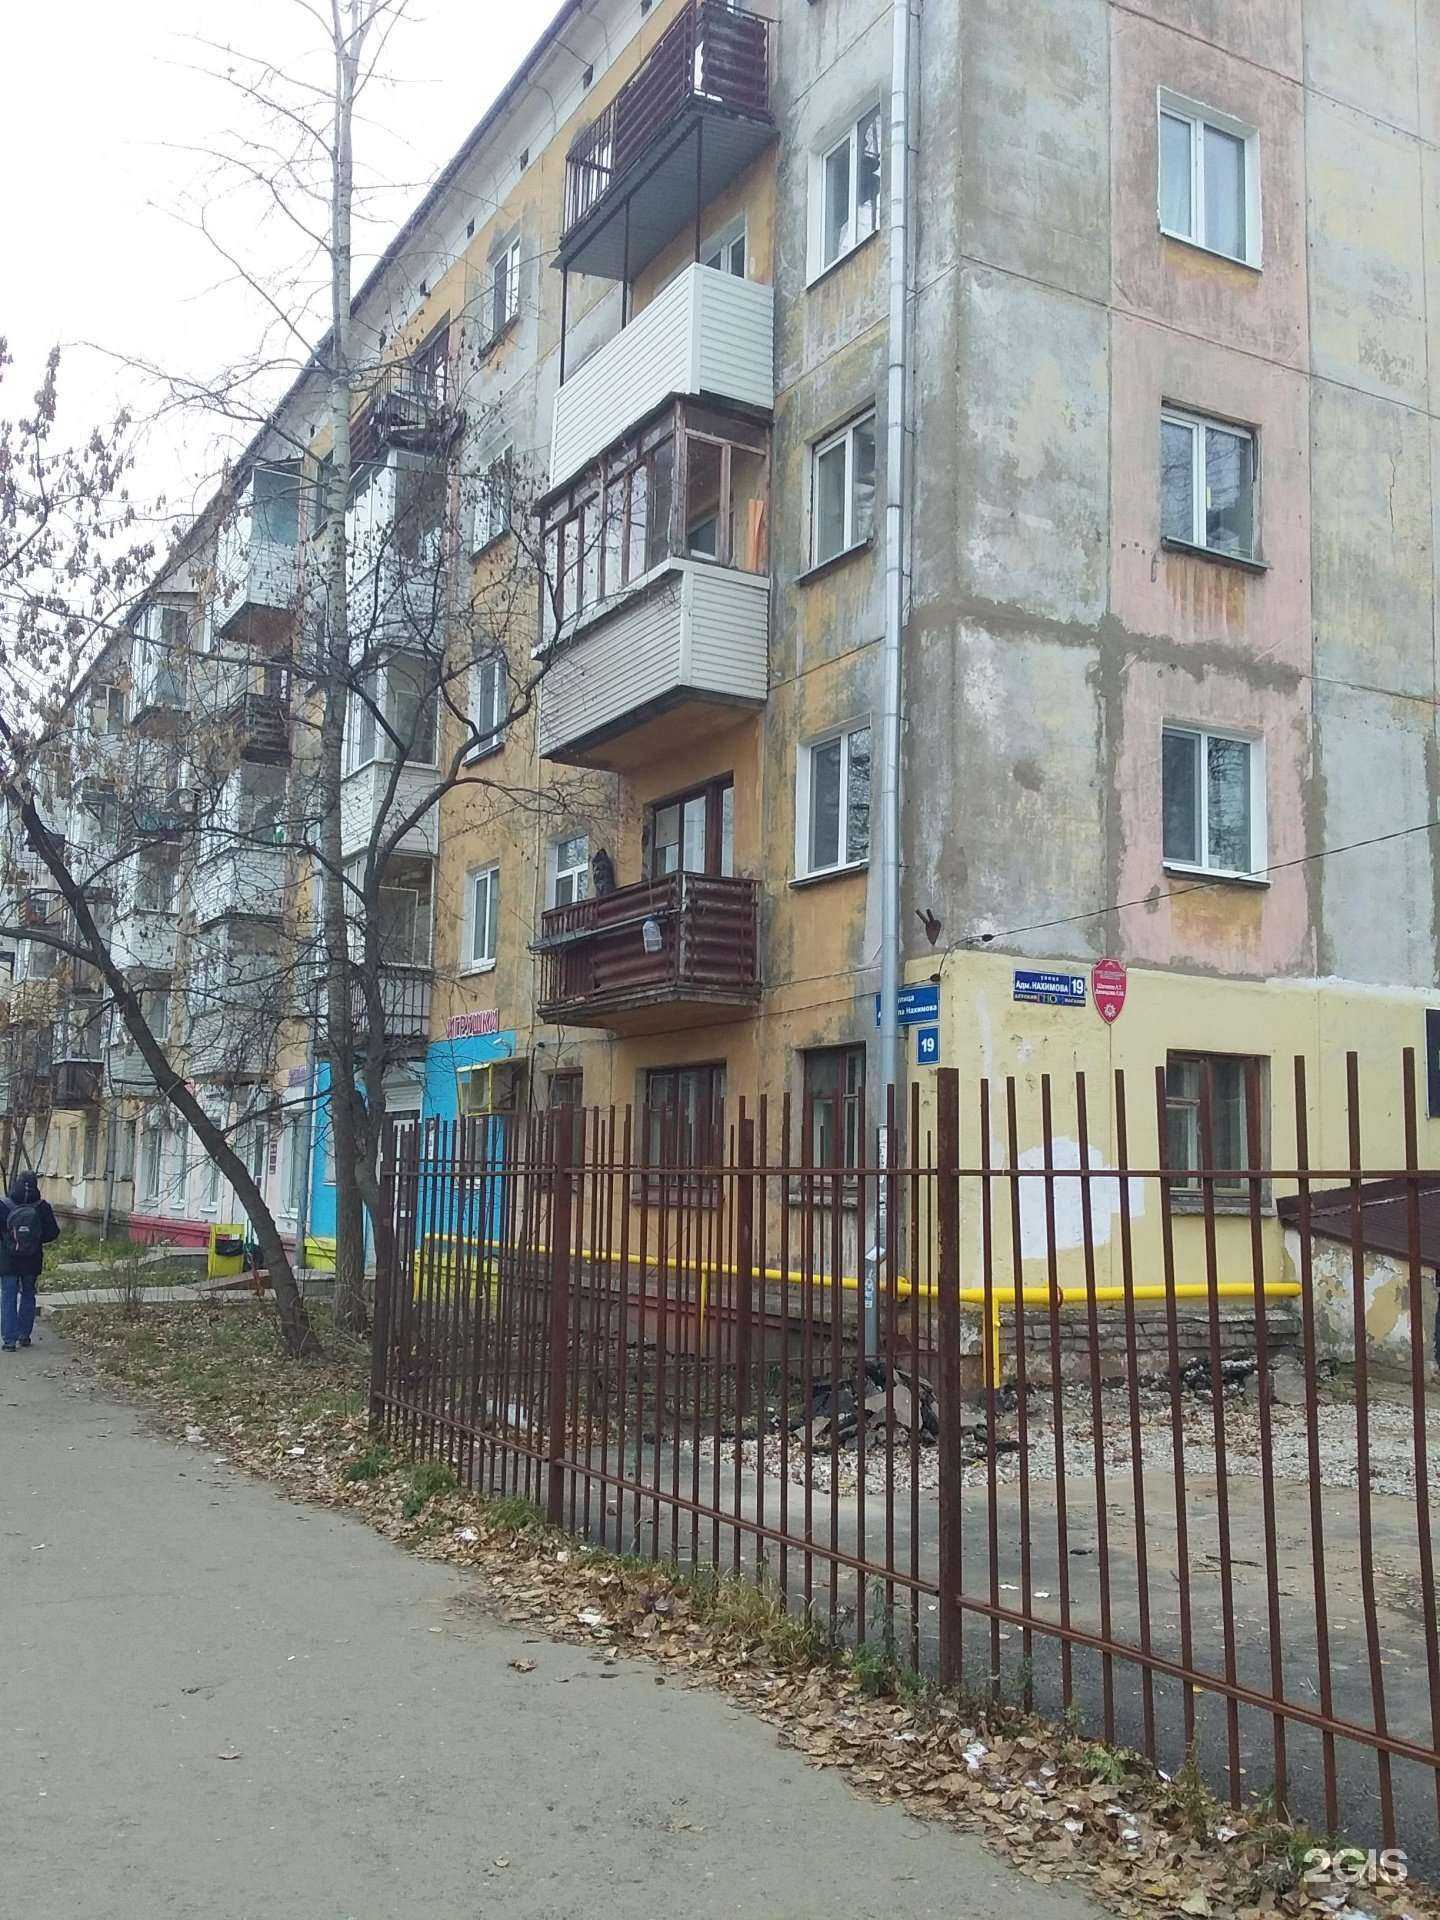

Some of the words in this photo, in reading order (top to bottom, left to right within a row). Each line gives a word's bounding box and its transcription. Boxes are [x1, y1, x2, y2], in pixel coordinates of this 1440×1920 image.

[1071, 978, 1084, 994] 19
[906, 1005, 938, 1015] Нахимова
[921, 1037, 935, 1053] 19
